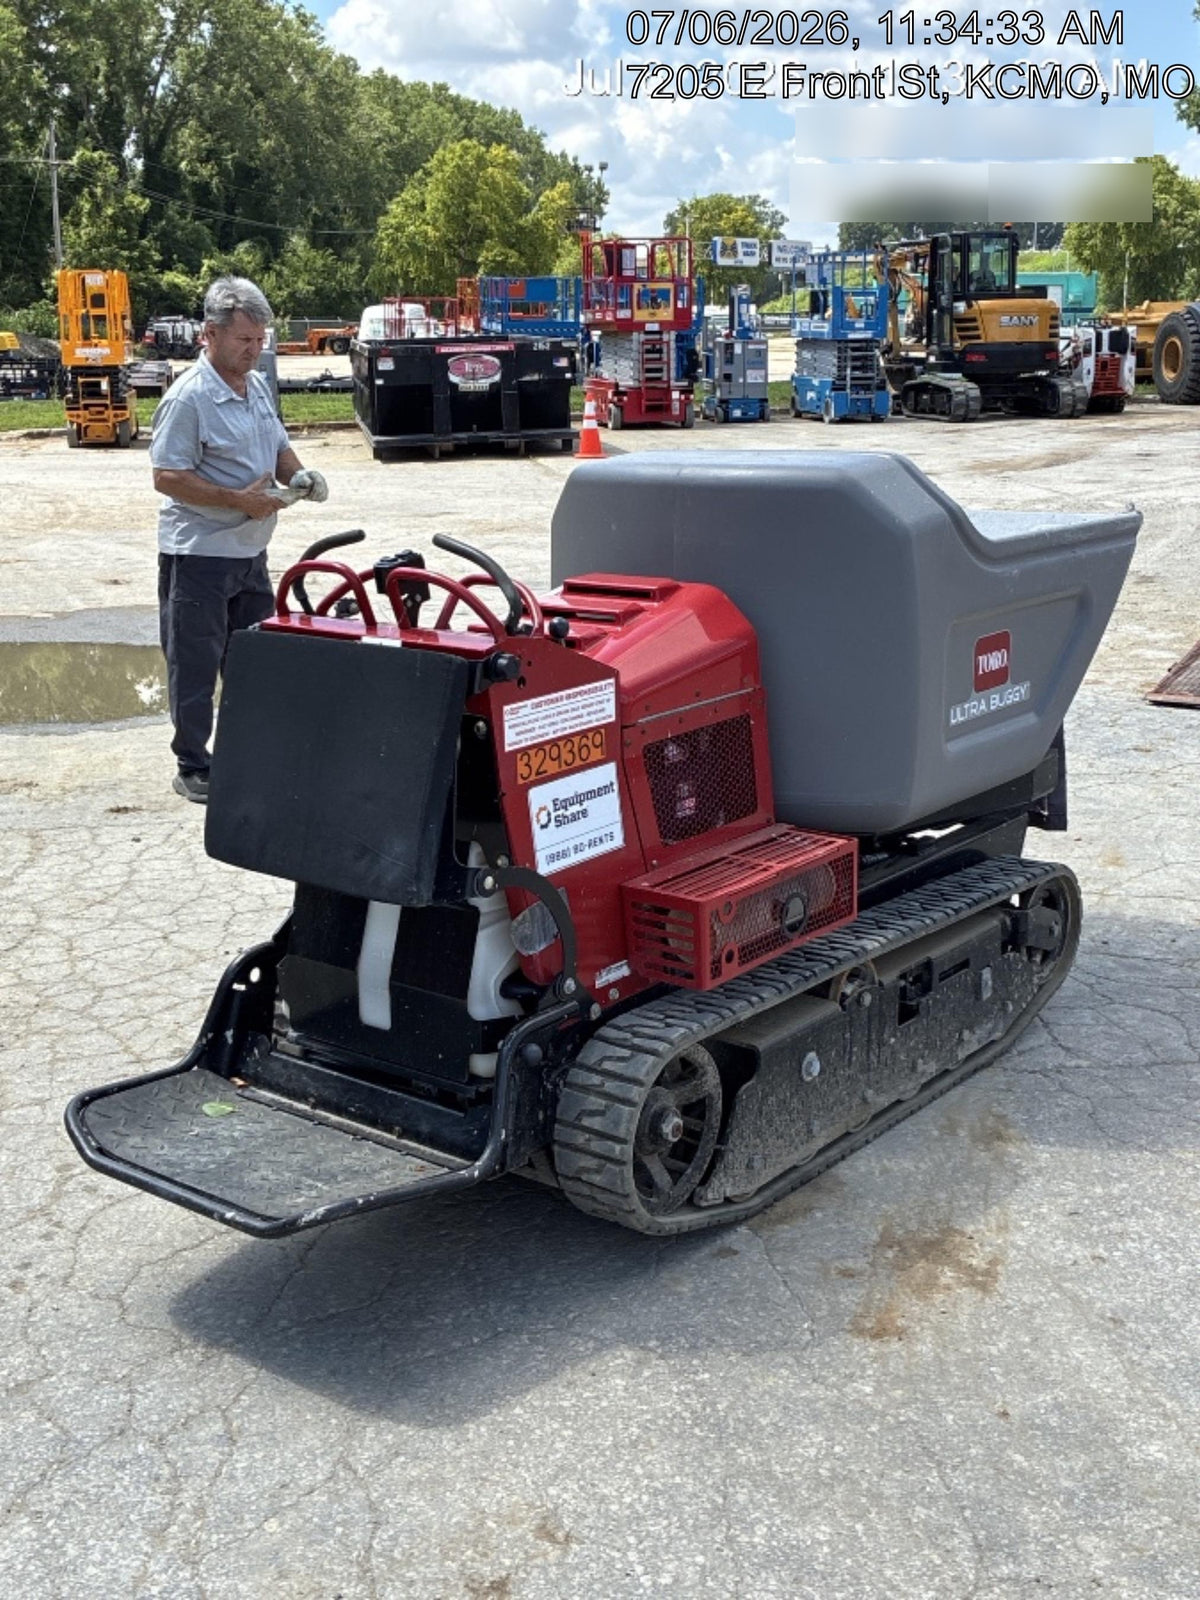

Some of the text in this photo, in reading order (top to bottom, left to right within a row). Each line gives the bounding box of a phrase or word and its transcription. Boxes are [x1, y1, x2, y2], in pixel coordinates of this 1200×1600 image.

[1000, 315, 1039, 328] SANY
[977, 648, 1008, 675] TORO
[949, 683, 1028, 726] ULTRA BUGGY
[519, 730, 604, 781] 329369
[552, 781, 616, 812] Equipment
[554, 808, 589, 828] Share
